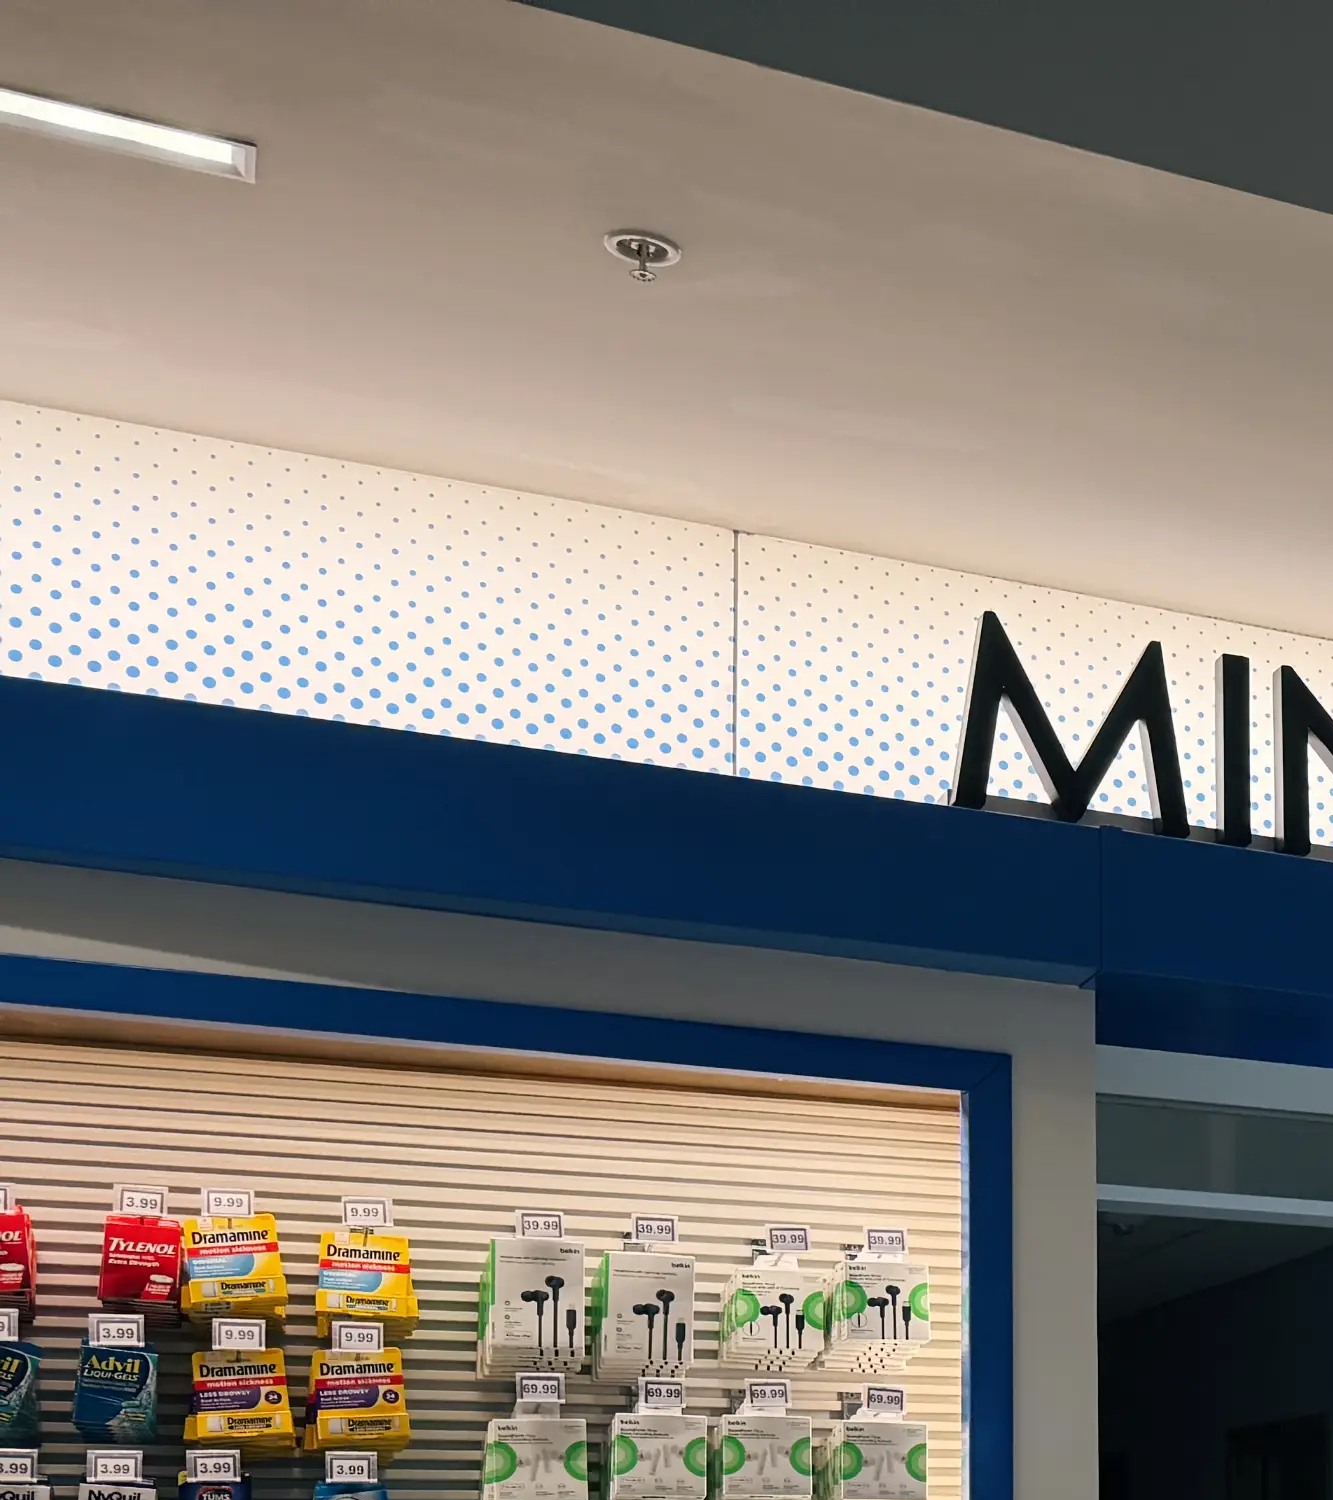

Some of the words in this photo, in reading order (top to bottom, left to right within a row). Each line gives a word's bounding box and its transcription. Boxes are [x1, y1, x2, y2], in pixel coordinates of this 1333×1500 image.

[126, 1197, 158, 1209] 3.99
[214, 1198, 244, 1207] 9.99
[350, 1207, 379, 1217] 9.99
[524, 1221, 558, 1230] 39.99
[638, 1224, 671, 1234] 39.99
[192, 1229, 269, 1246] Dramamine
[772, 1234, 804, 1244] 39.99
[870, 1236, 901, 1245] 39.99
[109, 1237, 177, 1255] TYLENOL
[327, 1244, 400, 1261] Dramamine
[102, 1328, 134, 1339] 3.99
[225, 1330, 254, 1340] 9.99
[345, 1333, 373, 1343] 9.99
[86, 1355, 142, 1373] Advil
[320, 1362, 395, 1376] Dramamine
[200, 1362, 277, 1377] Dramamine
[523, 1384, 557, 1394] 69.99
[648, 1388, 681, 1398] 69.99
[753, 1389, 785, 1399] 69.99
[870, 1393, 900, 1405] 69.99
[100, 1464, 130, 1474] 3.99
[200, 1462, 231, 1473] 3.99
[336, 1465, 364, 1475] 3.99
